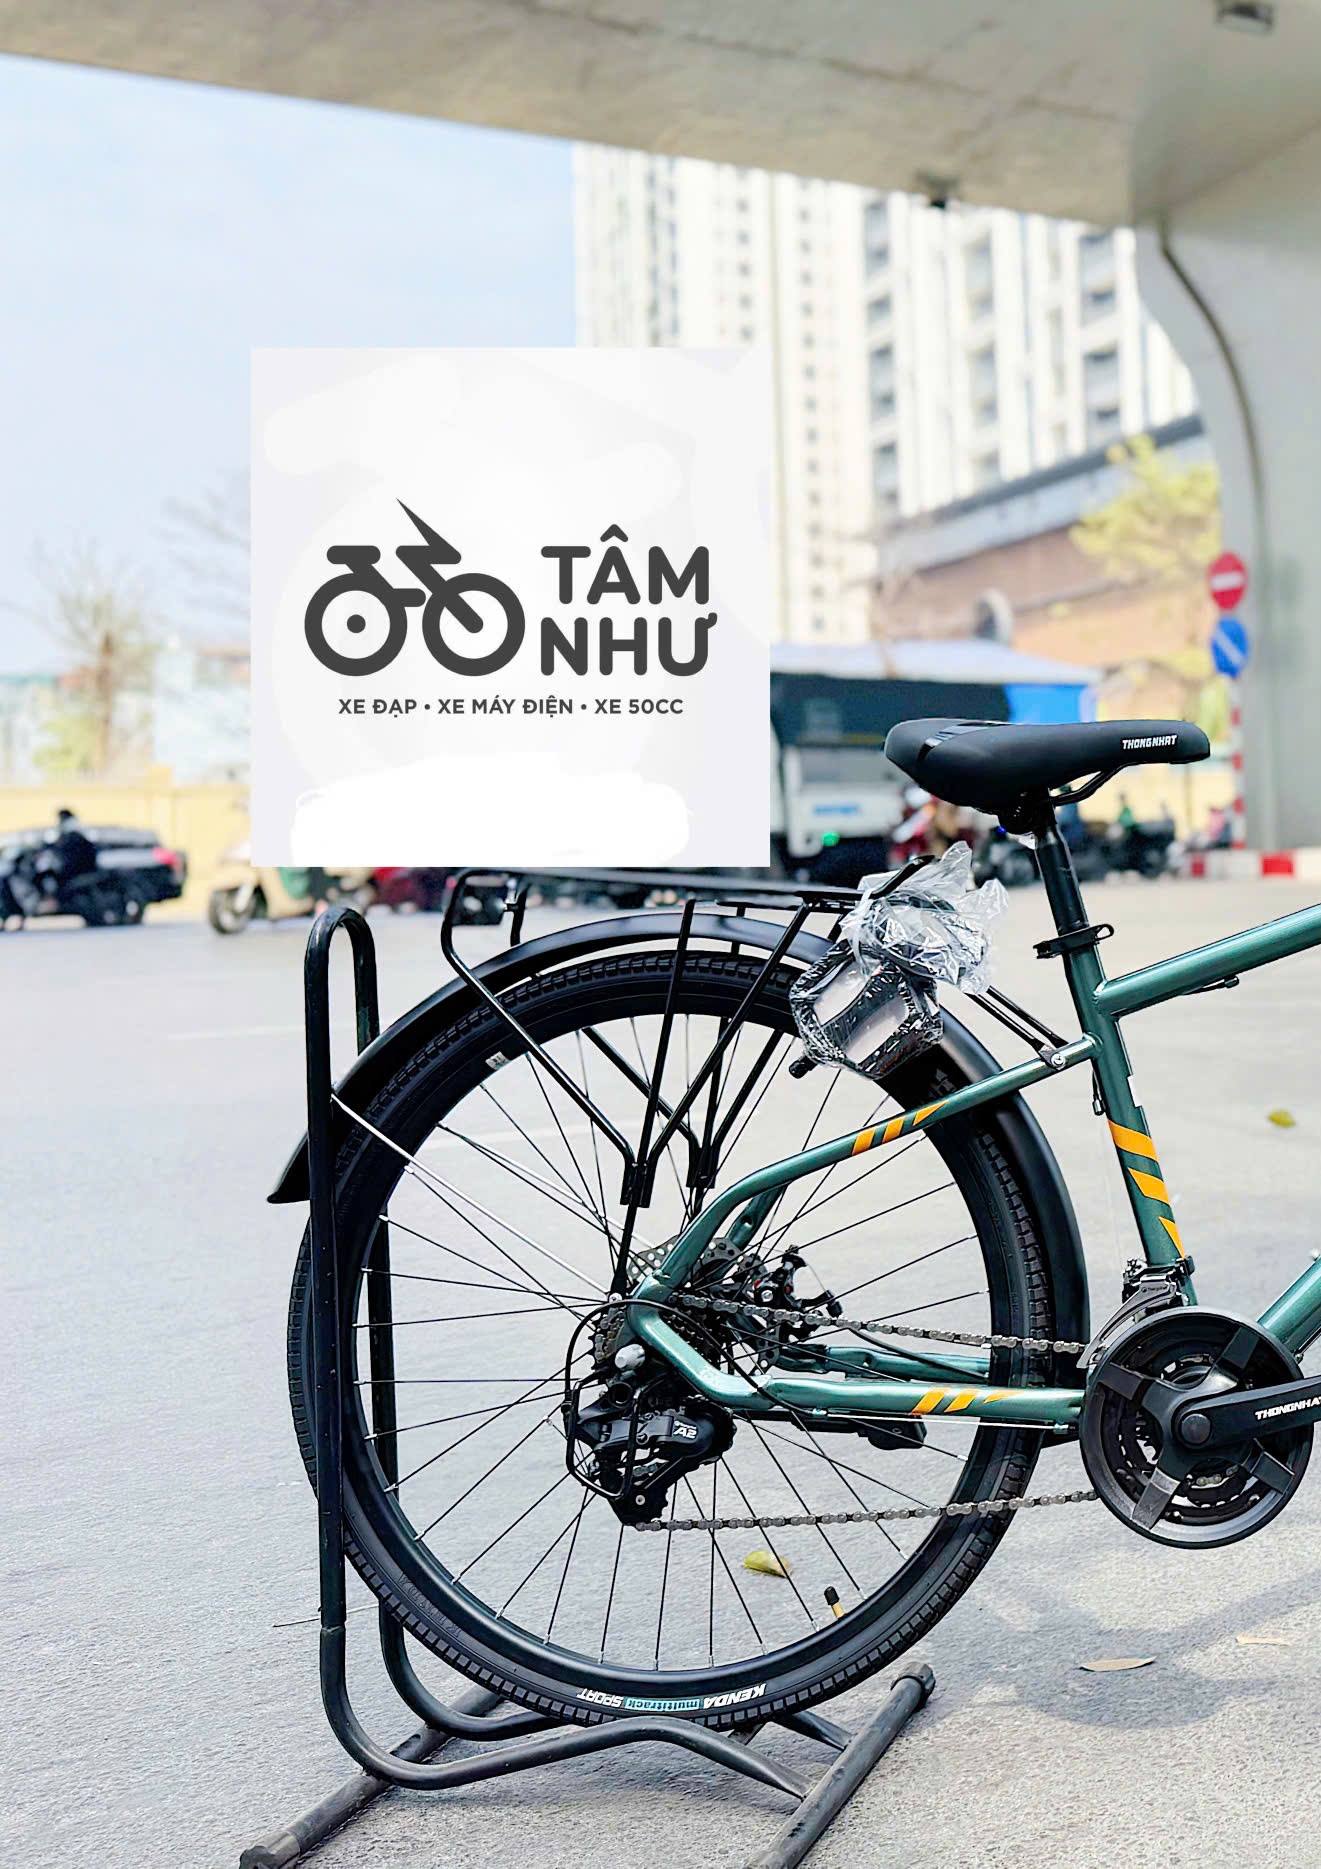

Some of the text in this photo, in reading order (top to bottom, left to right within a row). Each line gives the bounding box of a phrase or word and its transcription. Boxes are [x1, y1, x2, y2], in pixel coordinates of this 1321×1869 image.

[1122, 734, 1178, 750] THONGNHAT
[673, 1426, 697, 1439] A2
[576, 1683, 767, 1711] KENDA multitrack SPORT
